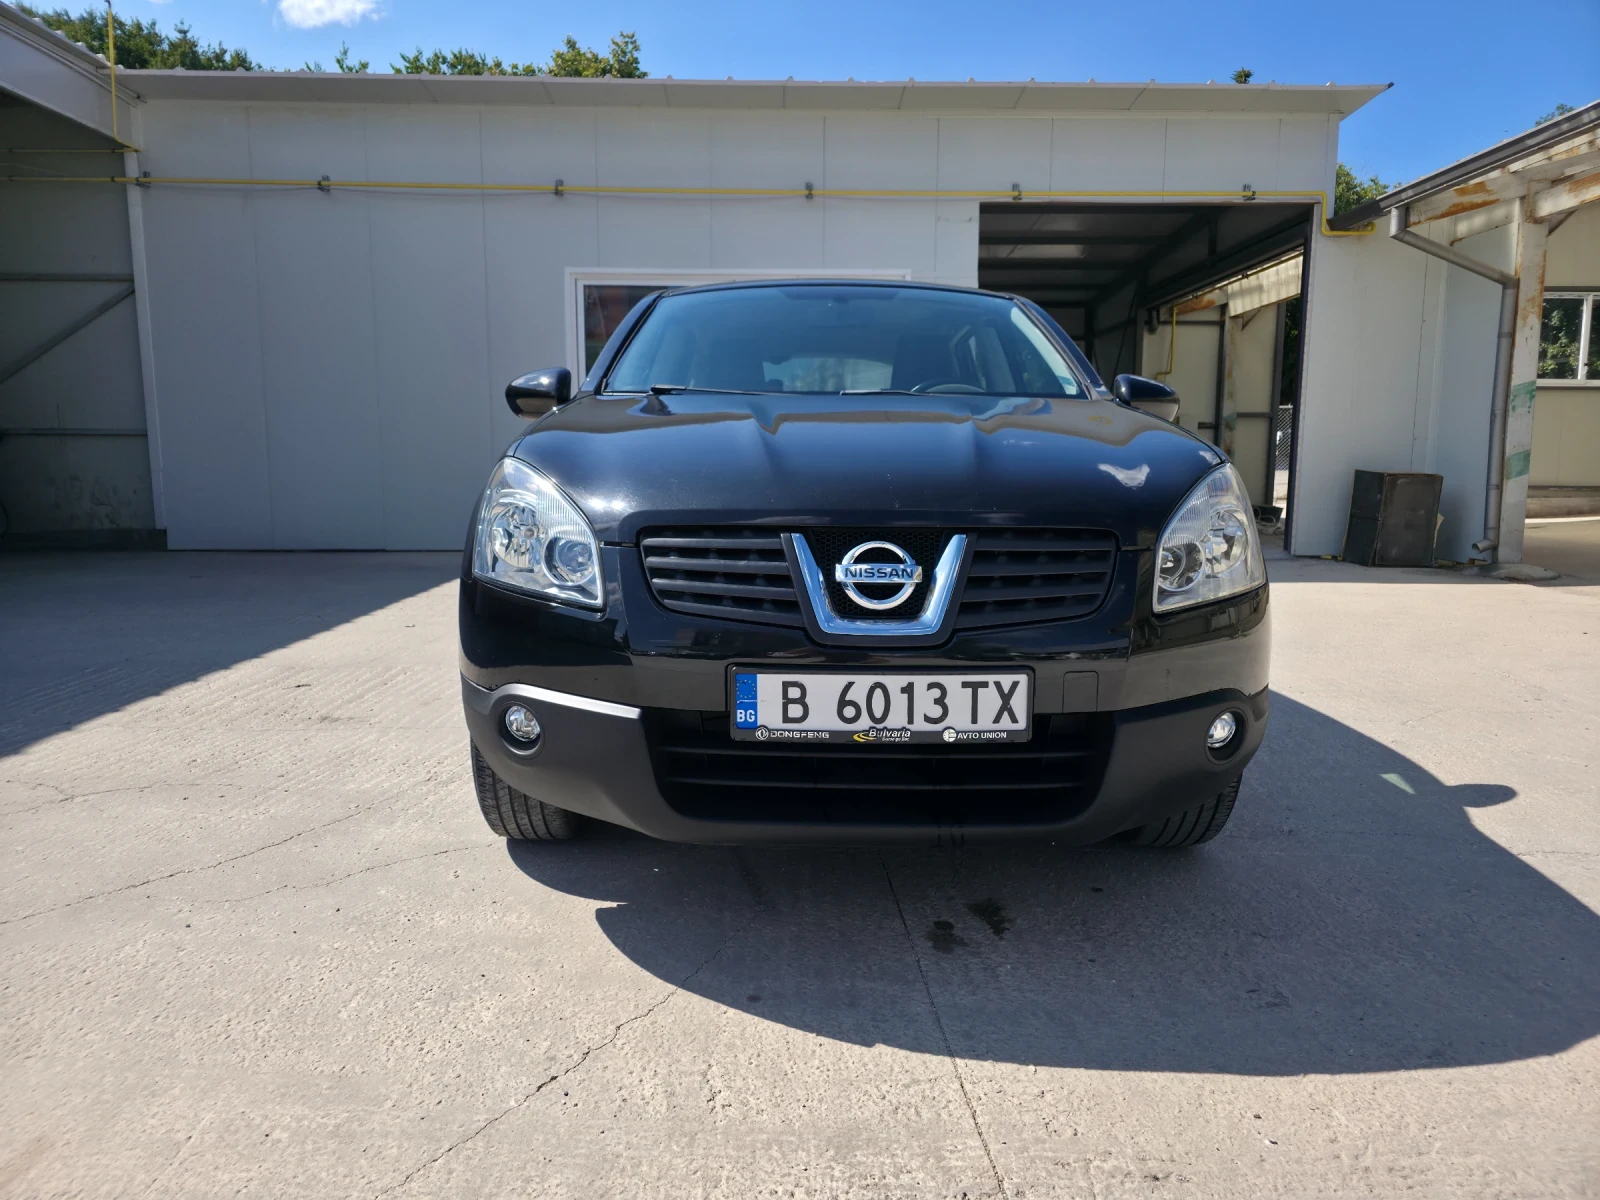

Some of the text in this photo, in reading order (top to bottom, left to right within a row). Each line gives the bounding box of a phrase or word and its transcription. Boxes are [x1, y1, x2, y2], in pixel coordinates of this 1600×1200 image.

[844, 567, 914, 579] NISSAN
[781, 680, 810, 724] B
[736, 709, 756, 722] BG
[770, 730, 830, 739] DONGFENG
[868, 728, 911, 738] Bulvaria
[981, 731, 1007, 739] UNION
